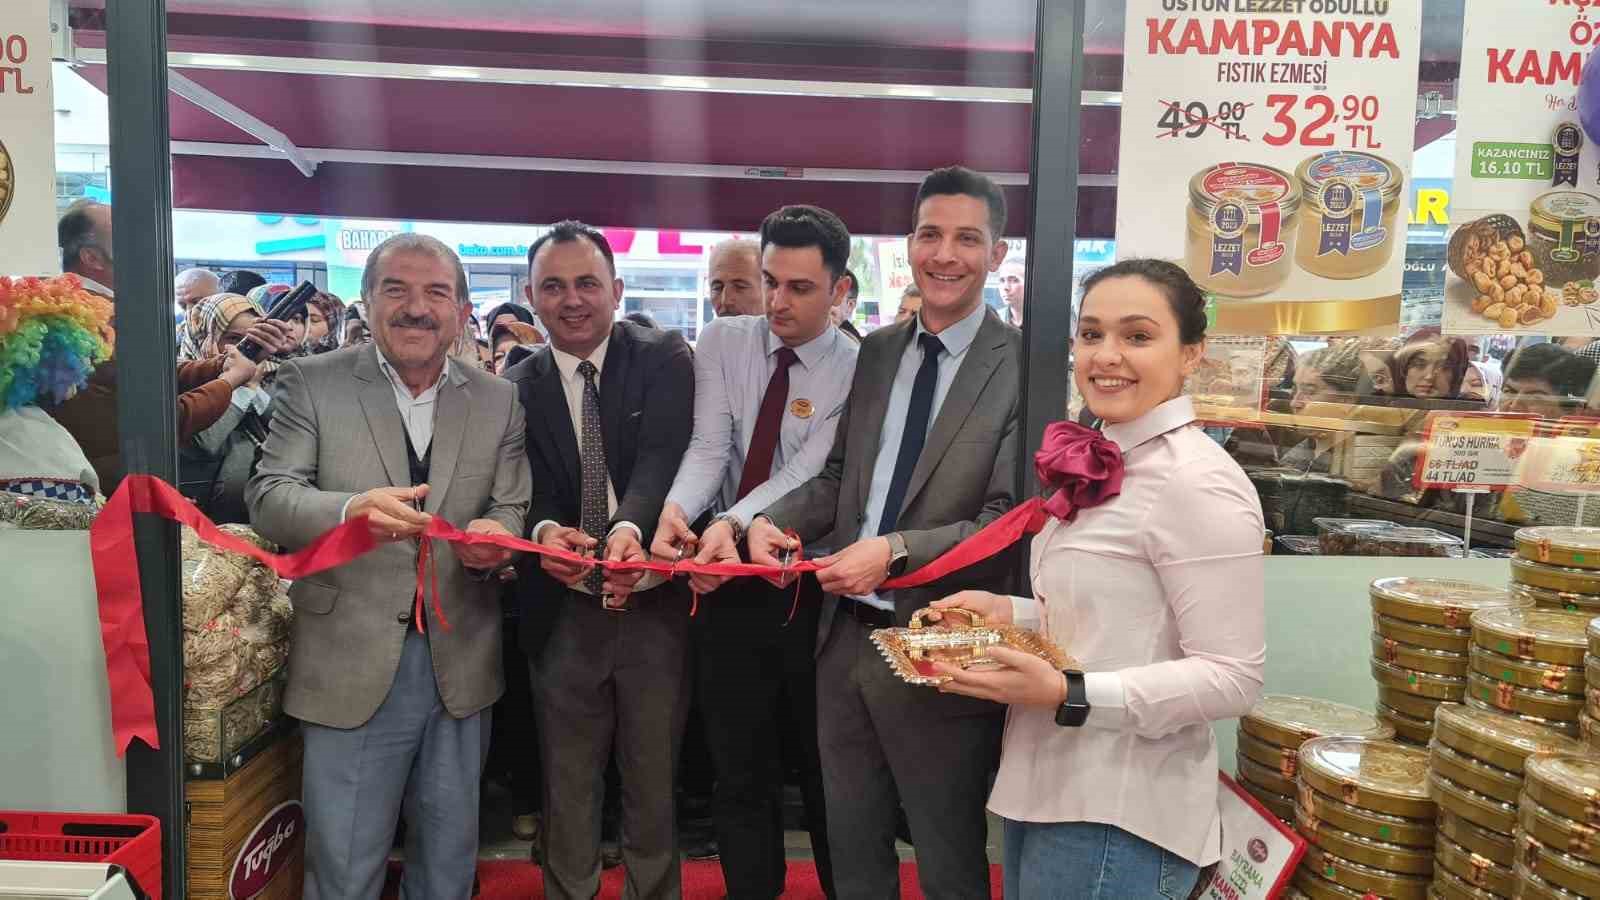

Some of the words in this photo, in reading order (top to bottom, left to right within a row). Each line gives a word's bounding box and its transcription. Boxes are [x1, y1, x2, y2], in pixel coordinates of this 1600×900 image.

[1234, 0, 1305, 14] LEZZET
[0, 34, 27, 64] 0
[1146, 18, 1400, 59] KAMPANYA
[1217, 62, 1265, 83] FISTIK
[1270, 60, 1328, 84] EZMESİ
[1345, 124, 1382, 149] TL
[1479, 160, 1521, 175] 16,10
[1526, 162, 1545, 176] TL
[1408, 188, 1450, 225] R
[1426, 470, 1439, 481] 44
[1443, 471, 1476, 483] TL/AD
